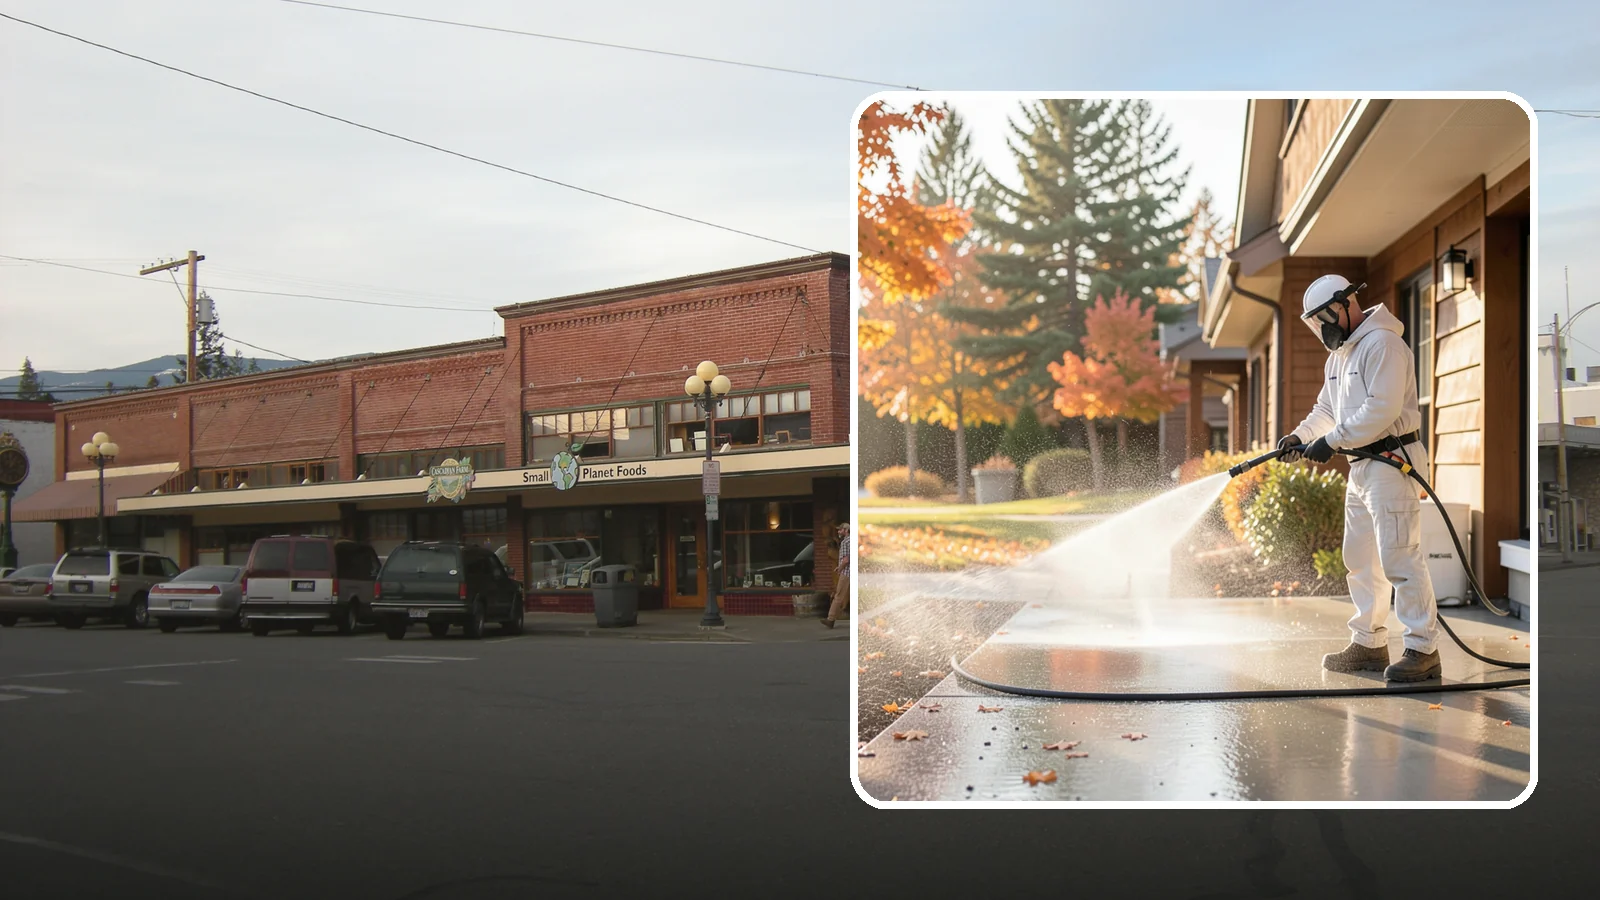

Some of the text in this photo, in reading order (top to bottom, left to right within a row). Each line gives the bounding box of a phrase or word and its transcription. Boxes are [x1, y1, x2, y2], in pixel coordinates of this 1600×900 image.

[523, 464, 647, 483] Small Planet Foods
